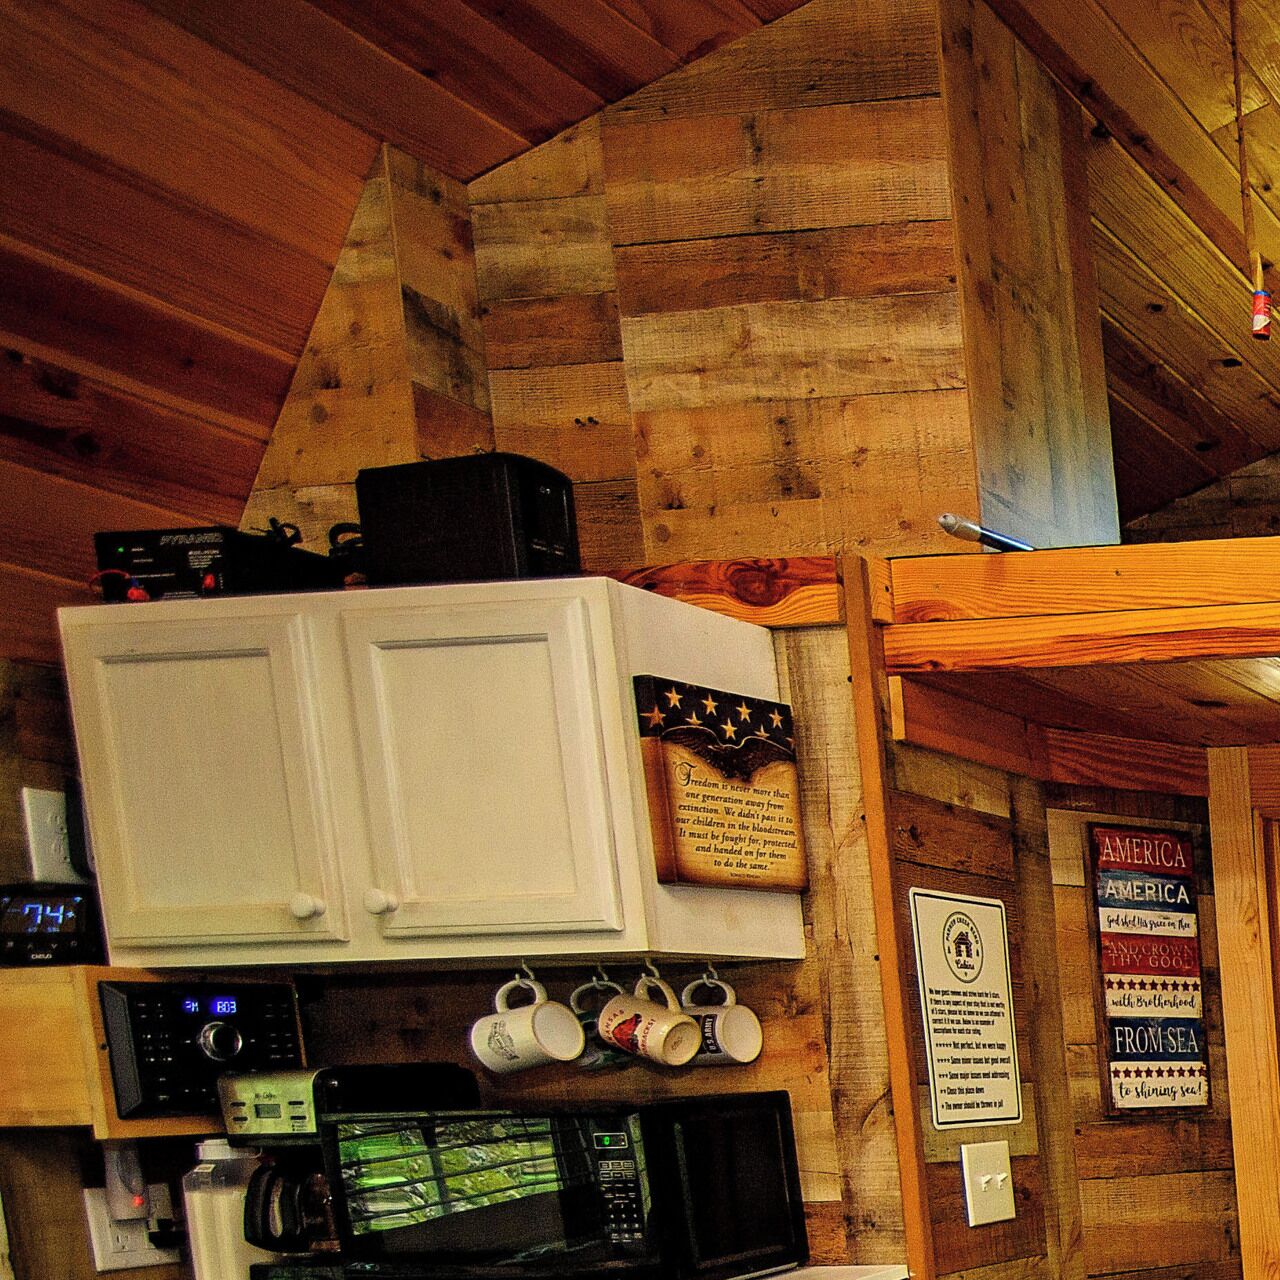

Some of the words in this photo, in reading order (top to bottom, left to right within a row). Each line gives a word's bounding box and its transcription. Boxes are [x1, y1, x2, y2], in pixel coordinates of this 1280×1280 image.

[731, 785, 750, 793] never
[753, 788, 770, 796] more
[773, 789, 790, 799] than
[686, 791, 699, 799] one
[702, 793, 743, 805] generation
[745, 797, 765, 810] away
[766, 801, 784, 811] from
[675, 816, 689, 824] our
[693, 817, 725, 829] children
[728, 821, 736, 829] in
[739, 822, 750, 831] the
[724, 807, 735, 816] We
[761, 813, 776, 823] pass
[778, 815, 784, 823] it
[680, 828, 686, 837] It
[689, 830, 708, 839] must
[711, 831, 719, 840] be
[721, 833, 746, 845] fought
[696, 844, 711, 852] and
[714, 845, 742, 855] handed
[756, 848, 766, 859] for
[769, 850, 786, 859] them
[1102, 836, 1186, 868] AMERICA
[724, 859, 733, 867] do
[736, 860, 747, 868] the
[1105, 880, 1190, 904] AMERICA
[22, 904, 64, 924] 74
[1107, 914, 1120, 928] God
[1121, 914, 1136, 926] shed
[1149, 919, 1166, 931] grace
[1108, 941, 1138, 955] AND
[1141, 943, 1194, 957] CROWN
[1108, 953, 1142, 967] THY
[1149, 955, 1194, 969] GOOD
[1111, 993, 1135, 1008] with
[1136, 993, 1196, 1009] Brotherhood
[704, 1018, 713, 1037] ARMY
[1114, 1026, 1163, 1054] FROM
[1167, 1026, 1199, 1053] SEA
[1119, 1082, 1131, 1098] to
[1135, 1081, 1178, 1101] shining
[1180, 1081, 1202, 1097] sea!
